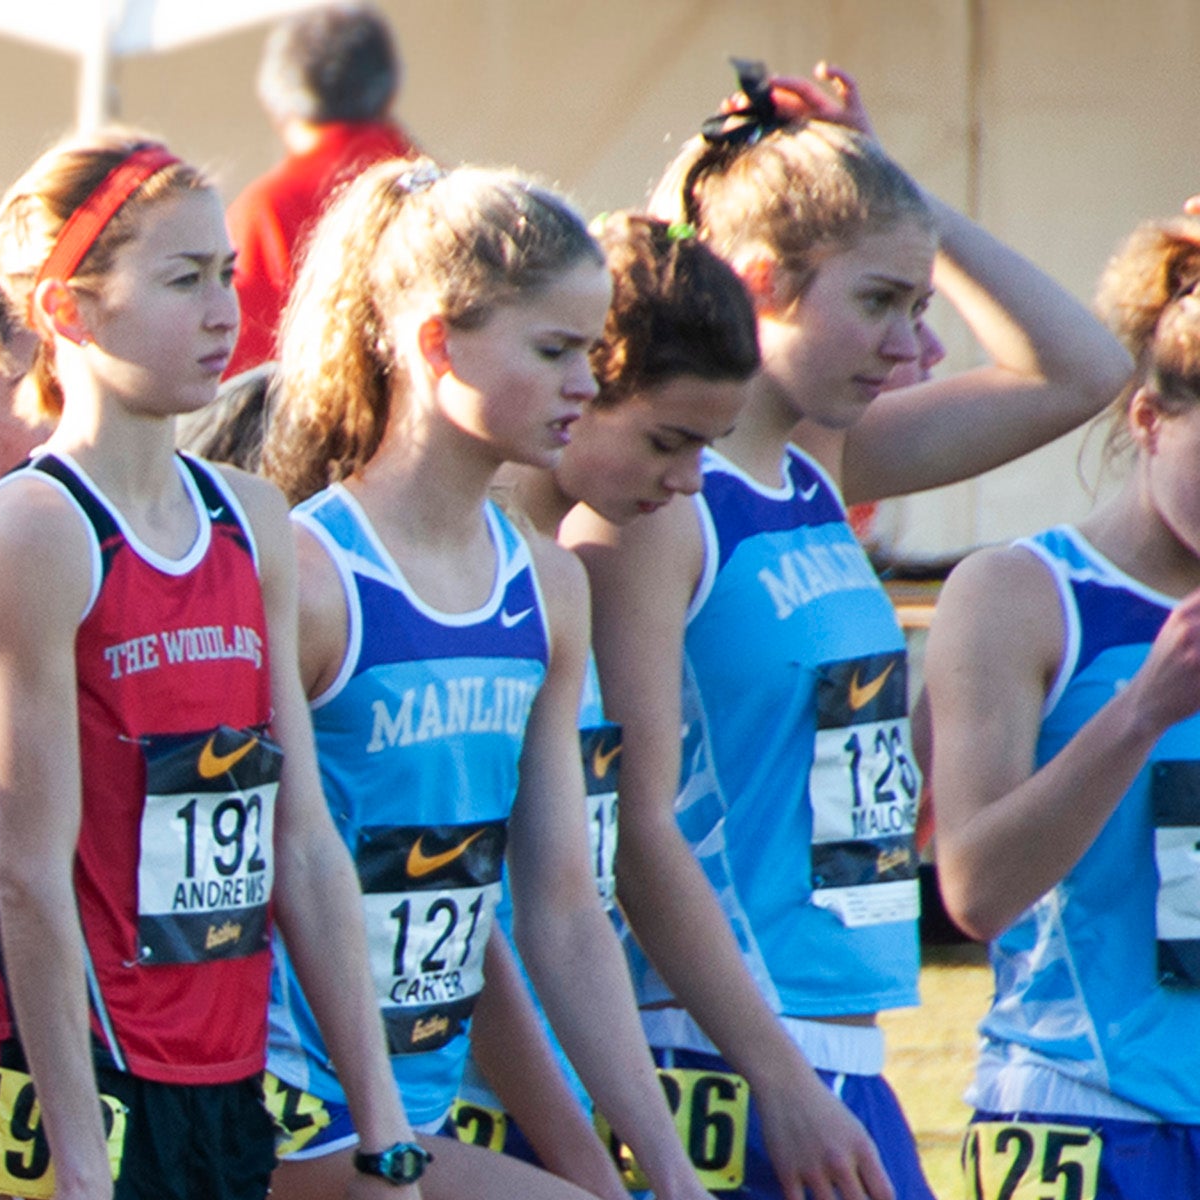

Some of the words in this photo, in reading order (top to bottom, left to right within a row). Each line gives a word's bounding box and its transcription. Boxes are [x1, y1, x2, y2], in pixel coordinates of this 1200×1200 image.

[104, 634, 159, 679] THE
[176, 793, 266, 879] 192
[172, 875, 265, 910] ANDREWS
[390, 893, 483, 976] 121
